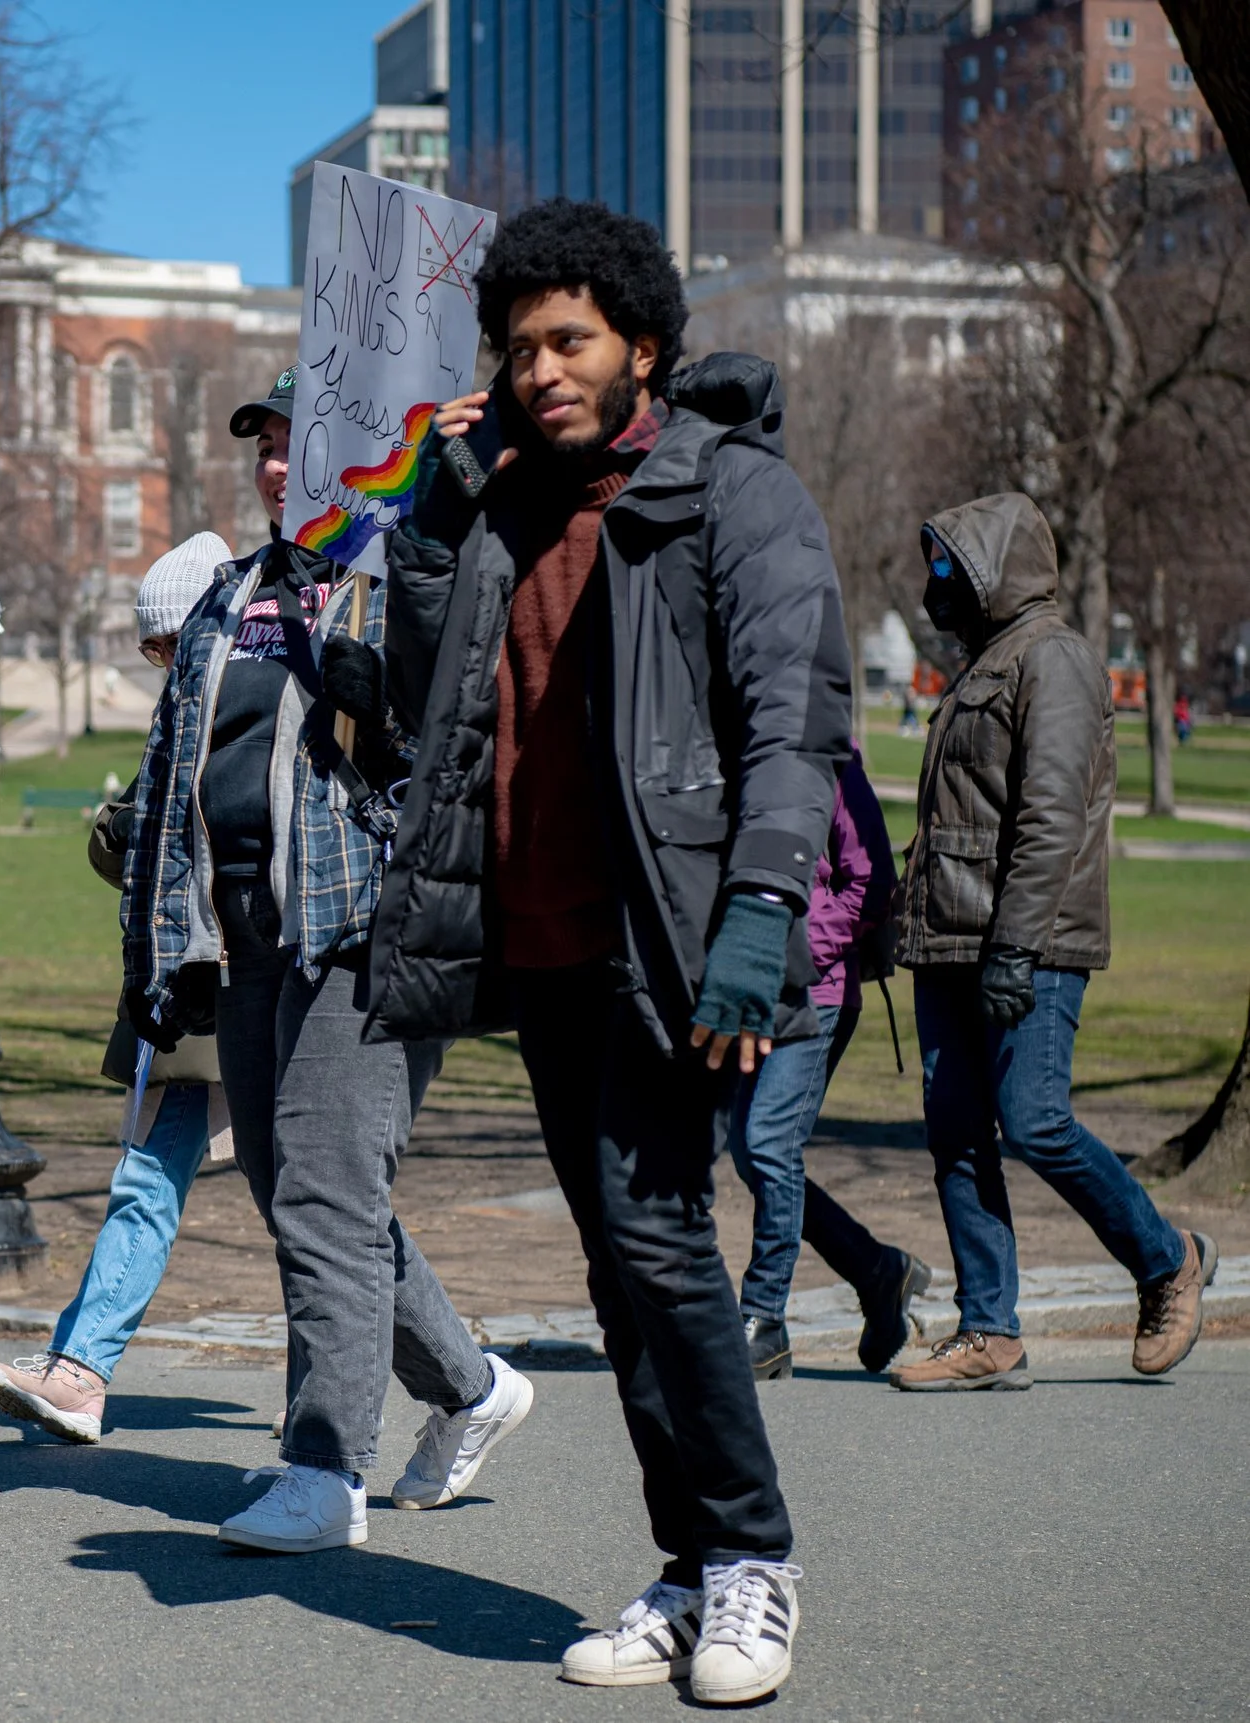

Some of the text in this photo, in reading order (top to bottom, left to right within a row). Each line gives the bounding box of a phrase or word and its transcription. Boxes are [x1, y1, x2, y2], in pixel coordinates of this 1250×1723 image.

[339, 175, 404, 284] NO
[314, 257, 408, 356] KINGS
[302, 420, 400, 527] Queen
